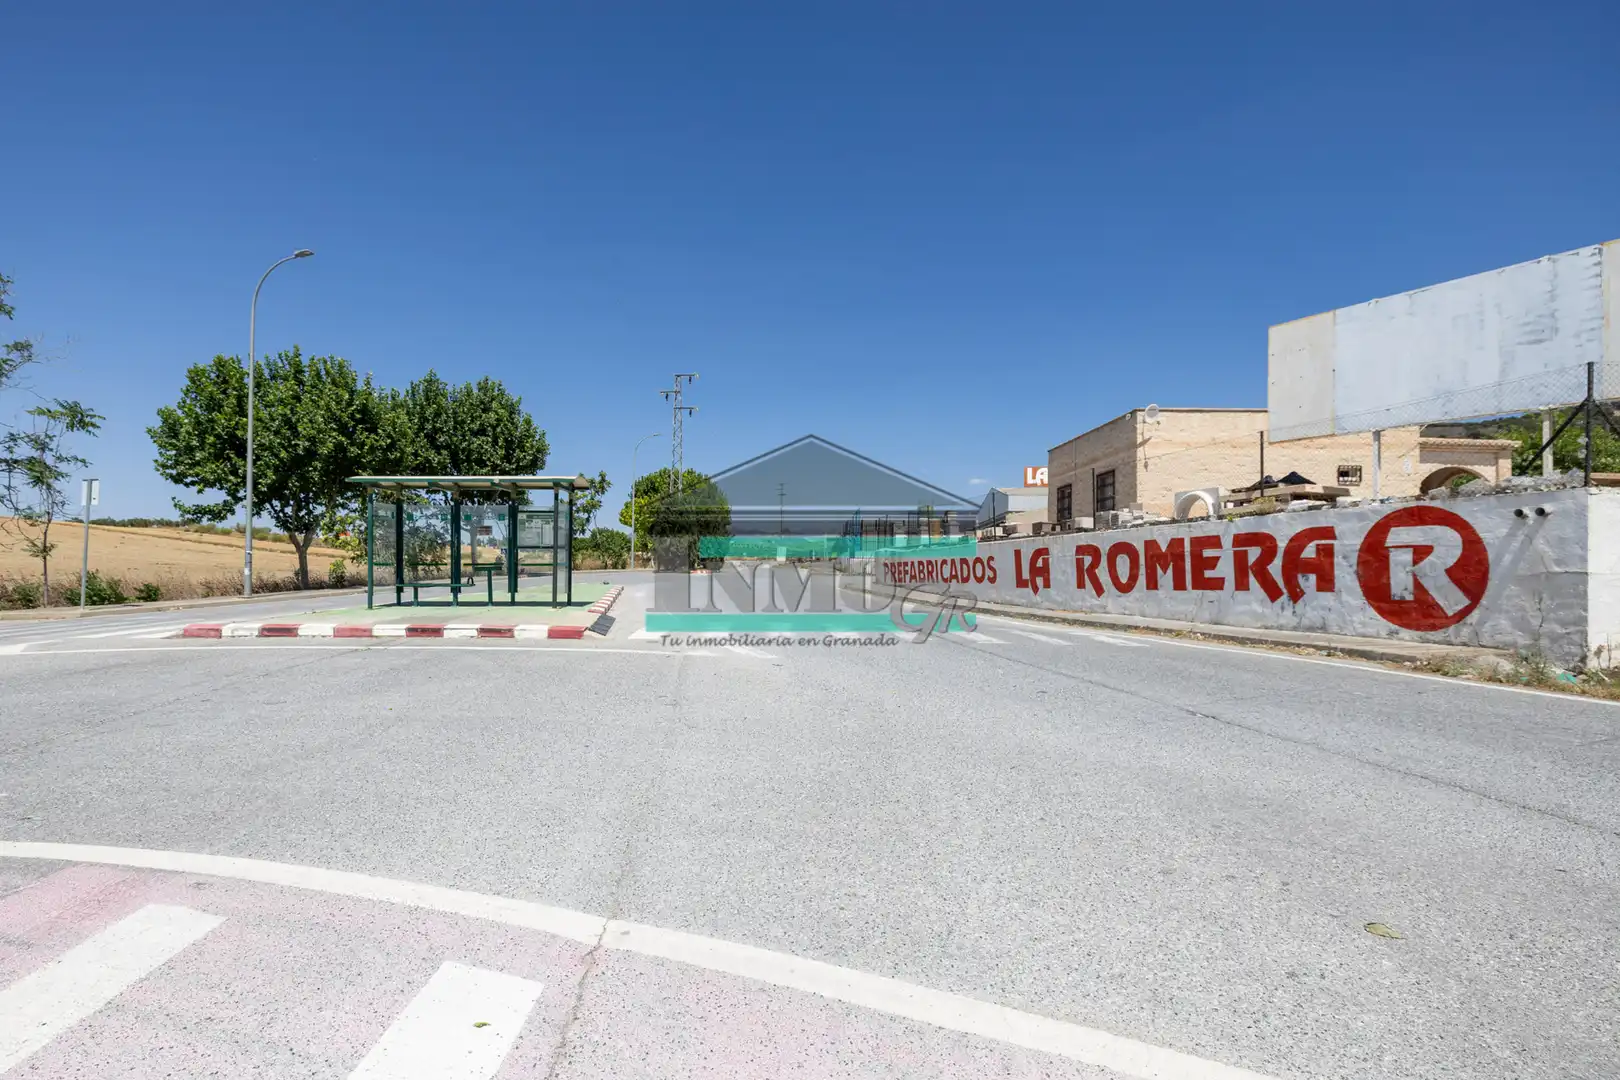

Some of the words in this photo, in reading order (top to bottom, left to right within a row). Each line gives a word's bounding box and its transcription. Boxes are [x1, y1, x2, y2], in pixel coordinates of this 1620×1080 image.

[1026, 467, 1048, 486] LA
[883, 555, 997, 585] PREFABRICADOS
[1014, 547, 1051, 596] LA
[1075, 526, 1337, 603] ROMERA
[1384, 526, 1472, 617] R
